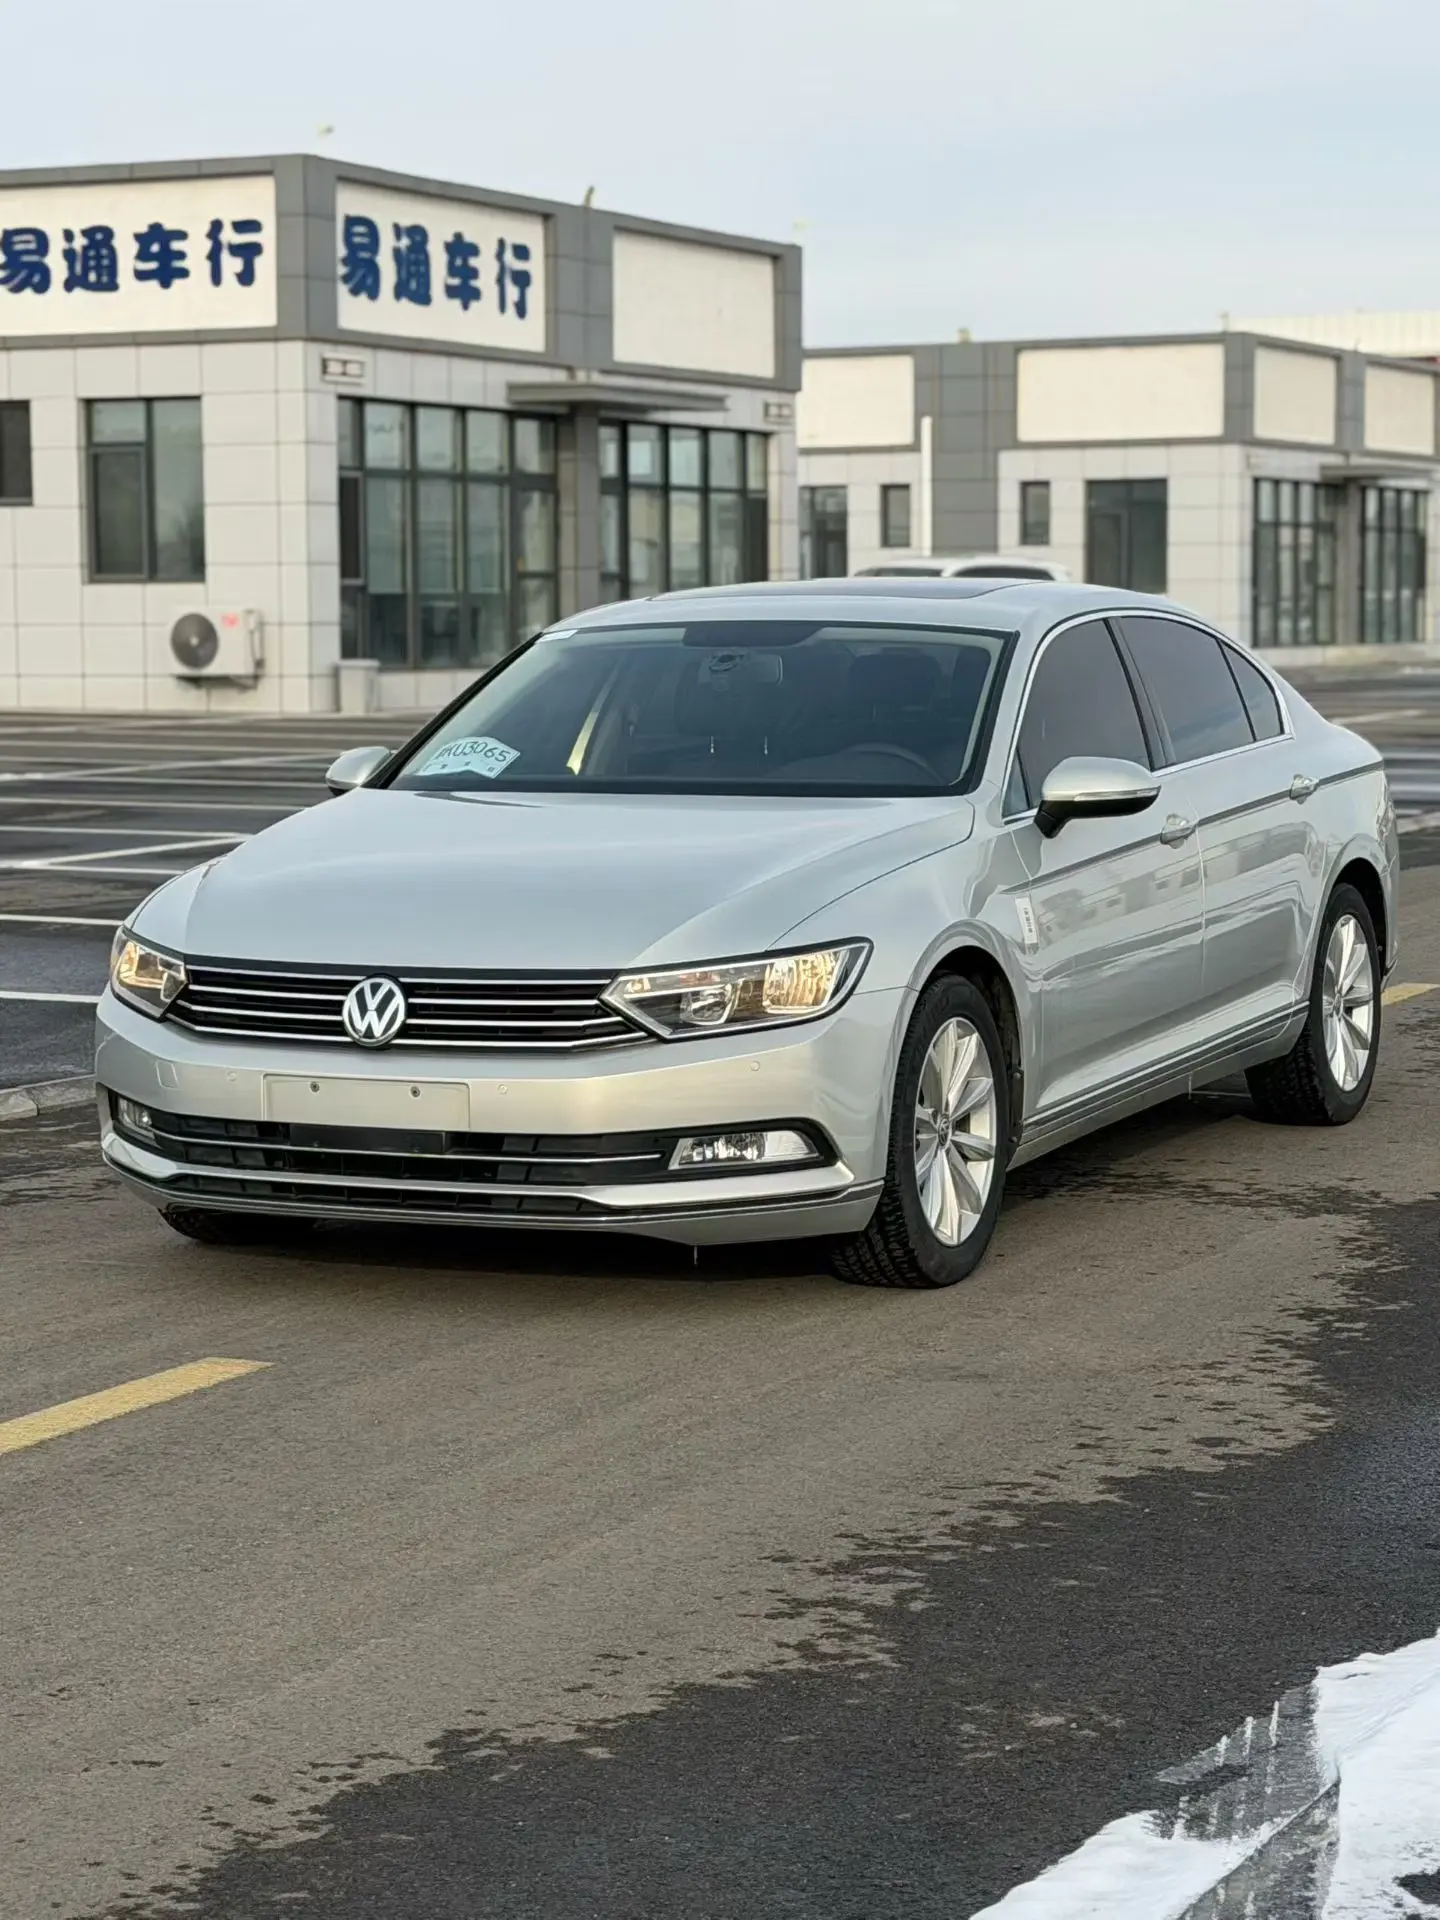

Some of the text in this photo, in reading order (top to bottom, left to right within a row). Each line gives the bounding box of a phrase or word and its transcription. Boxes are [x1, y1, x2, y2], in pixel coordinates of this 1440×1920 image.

[0, 218, 263, 294] 易通车行
[340, 214, 531, 319] 易通车行
